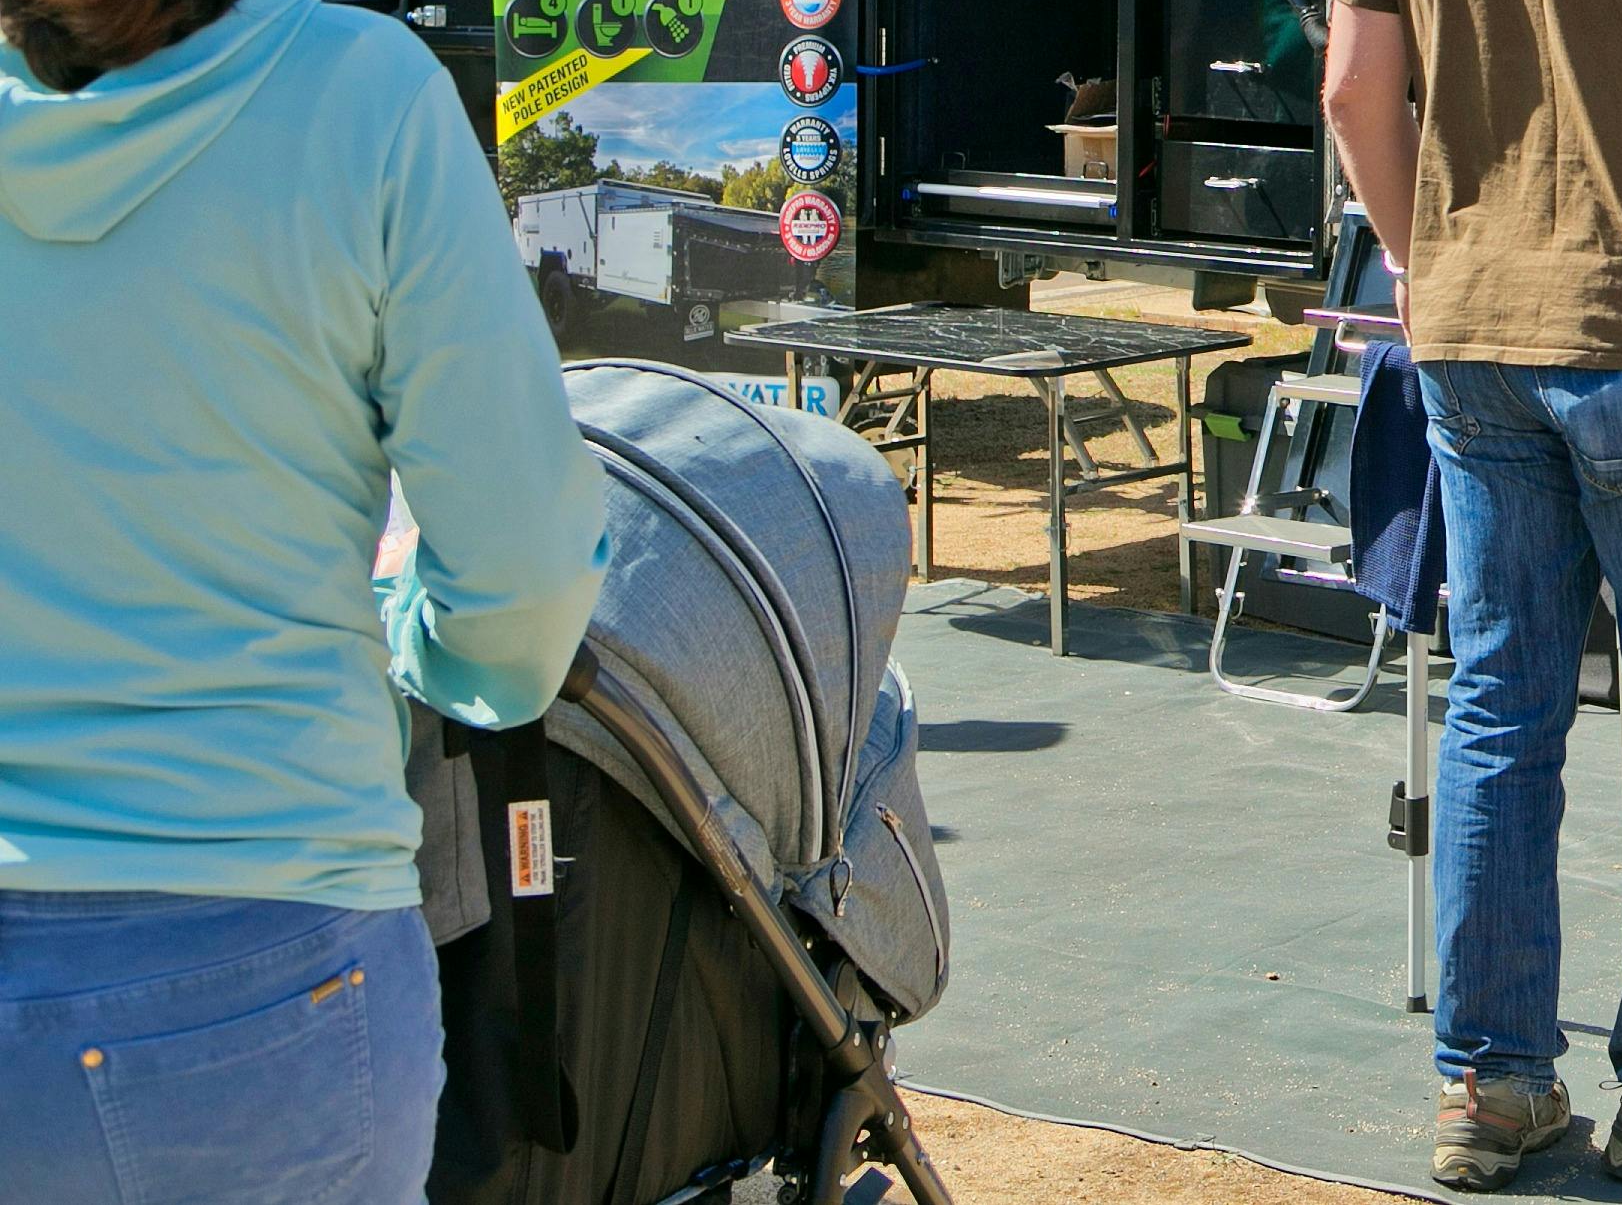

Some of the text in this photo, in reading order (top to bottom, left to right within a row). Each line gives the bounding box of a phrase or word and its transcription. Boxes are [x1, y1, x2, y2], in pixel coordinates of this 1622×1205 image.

[803, 0, 837, 25] WARRANTY
[792, 41, 826, 55] PREMIUM
[502, 54, 589, 115] NEW PATENTED
[513, 71, 590, 126] POLE DESIGN
[804, 82, 834, 102] ZIPPERS
[789, 118, 831, 135] WARRANTY
[783, 147, 838, 180] LOVELLS SPRINGS
[804, 196, 836, 224] WARRANTY
[518, 825, 530, 871] WARNING
